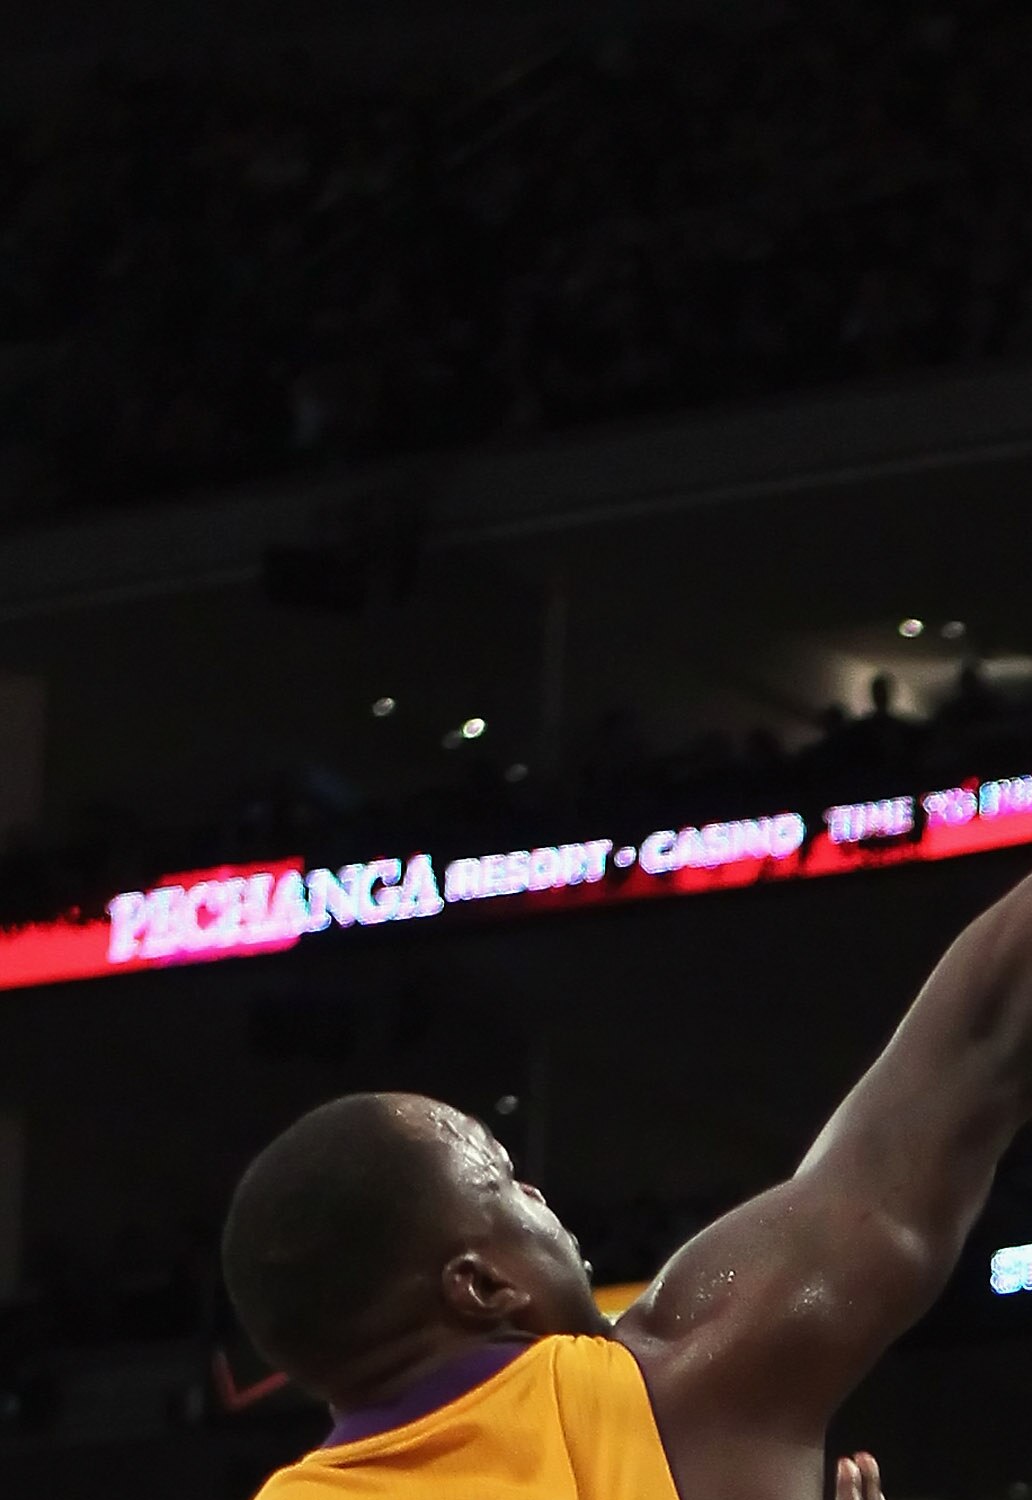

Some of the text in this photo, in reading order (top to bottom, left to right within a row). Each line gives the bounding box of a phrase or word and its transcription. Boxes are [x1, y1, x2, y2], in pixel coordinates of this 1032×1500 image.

[108, 854, 443, 962] PECHANGA
[445, 840, 612, 901] RESORT
[640, 813, 804, 874] CASINO
